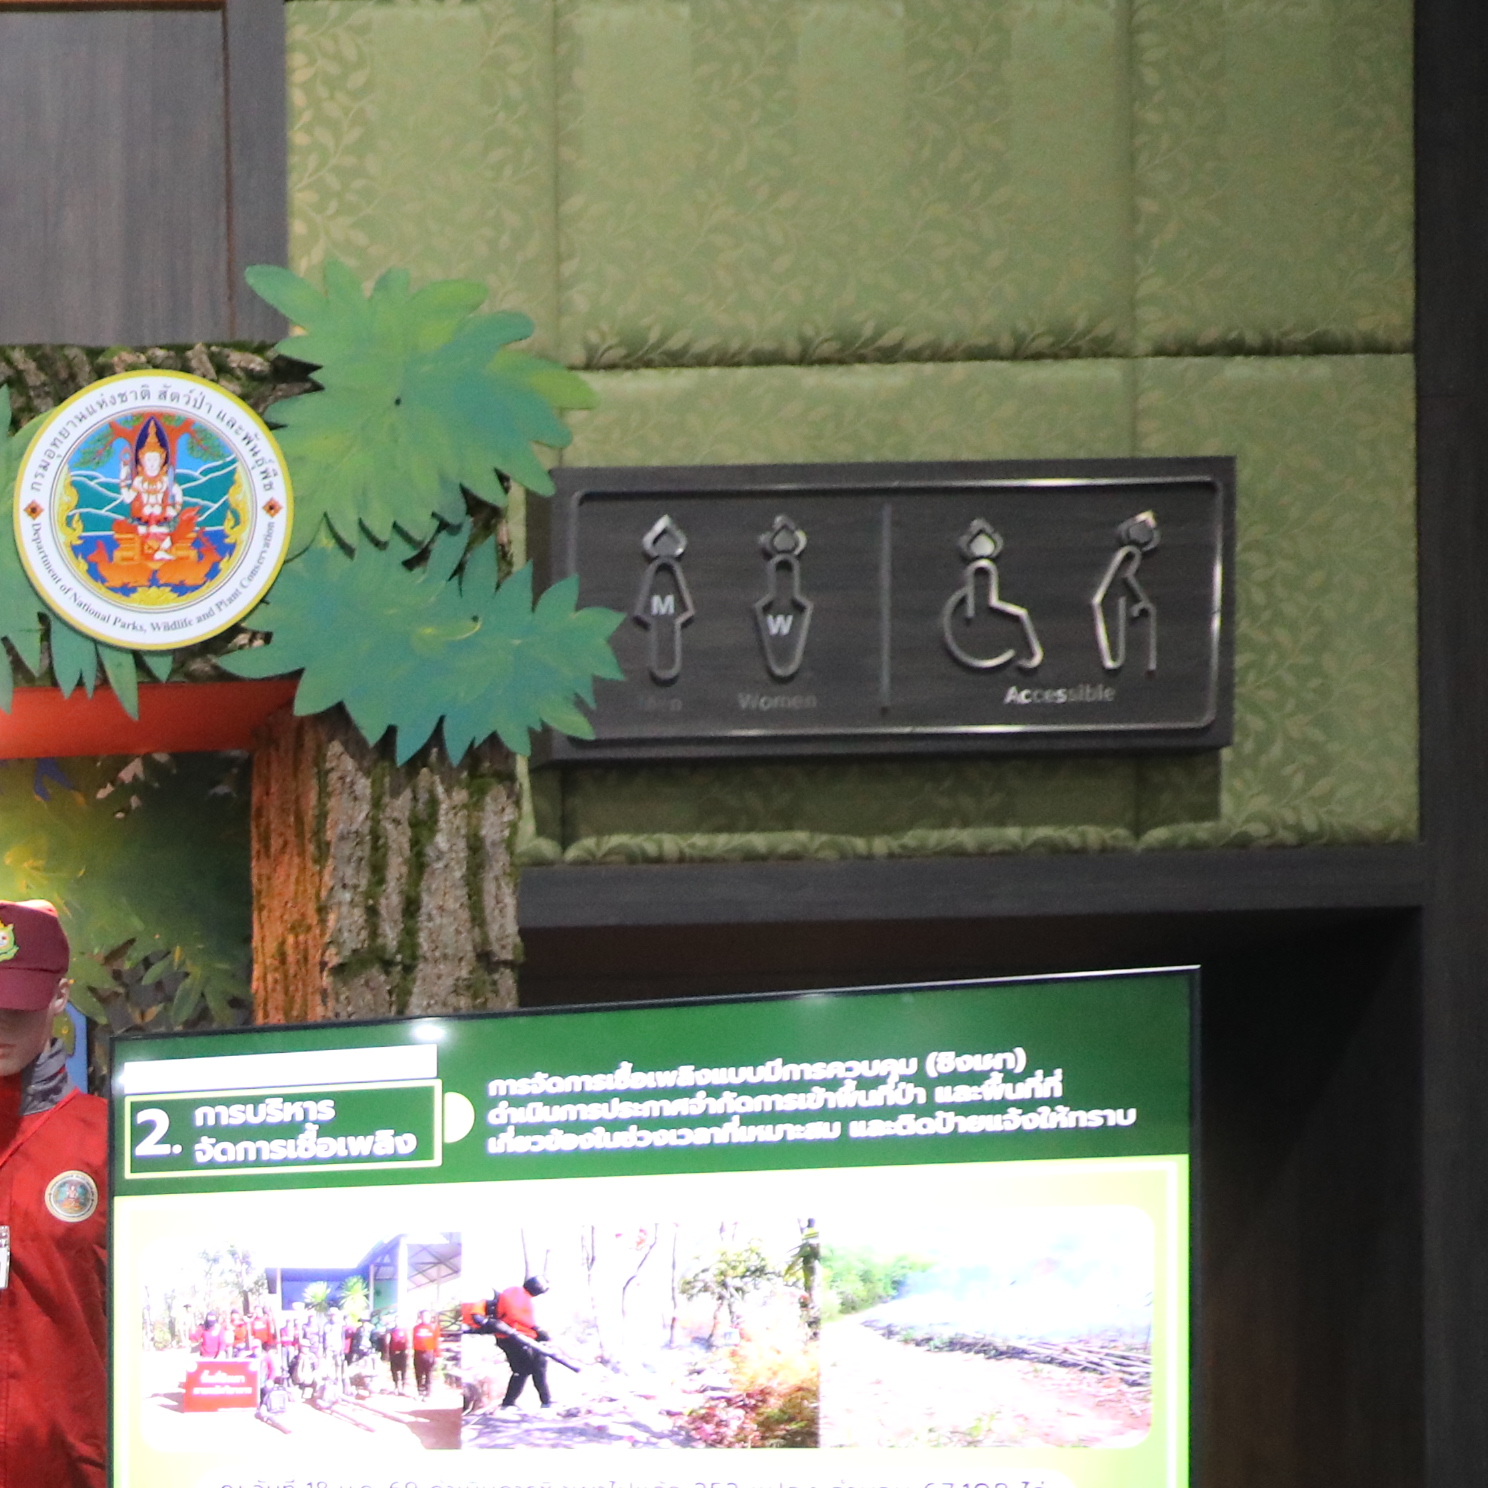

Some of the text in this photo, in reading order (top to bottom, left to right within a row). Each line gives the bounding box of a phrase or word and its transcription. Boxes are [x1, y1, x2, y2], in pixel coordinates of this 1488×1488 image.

[31, 383, 279, 492] กรมอุทยานแห่งชาติ สัตว์ป่า และพันธุ์พืช
[31, 523, 62, 588] Department
[60, 580, 72, 595] of
[68, 592, 113, 624] National
[112, 616, 147, 633] Parks,
[150, 615, 194, 632] Wildlife
[196, 607, 217, 625] and
[238, 521, 276, 590] Conservation
[651, 595, 675, 615] M
[768, 615, 793, 635] W
[1004, 684, 1116, 705] Accessible
[193, 1098, 336, 1128] การบริหาร
[133, 1105, 183, 1158] 2.
[192, 1123, 418, 1165] จัดการเชื้อเพลิง
